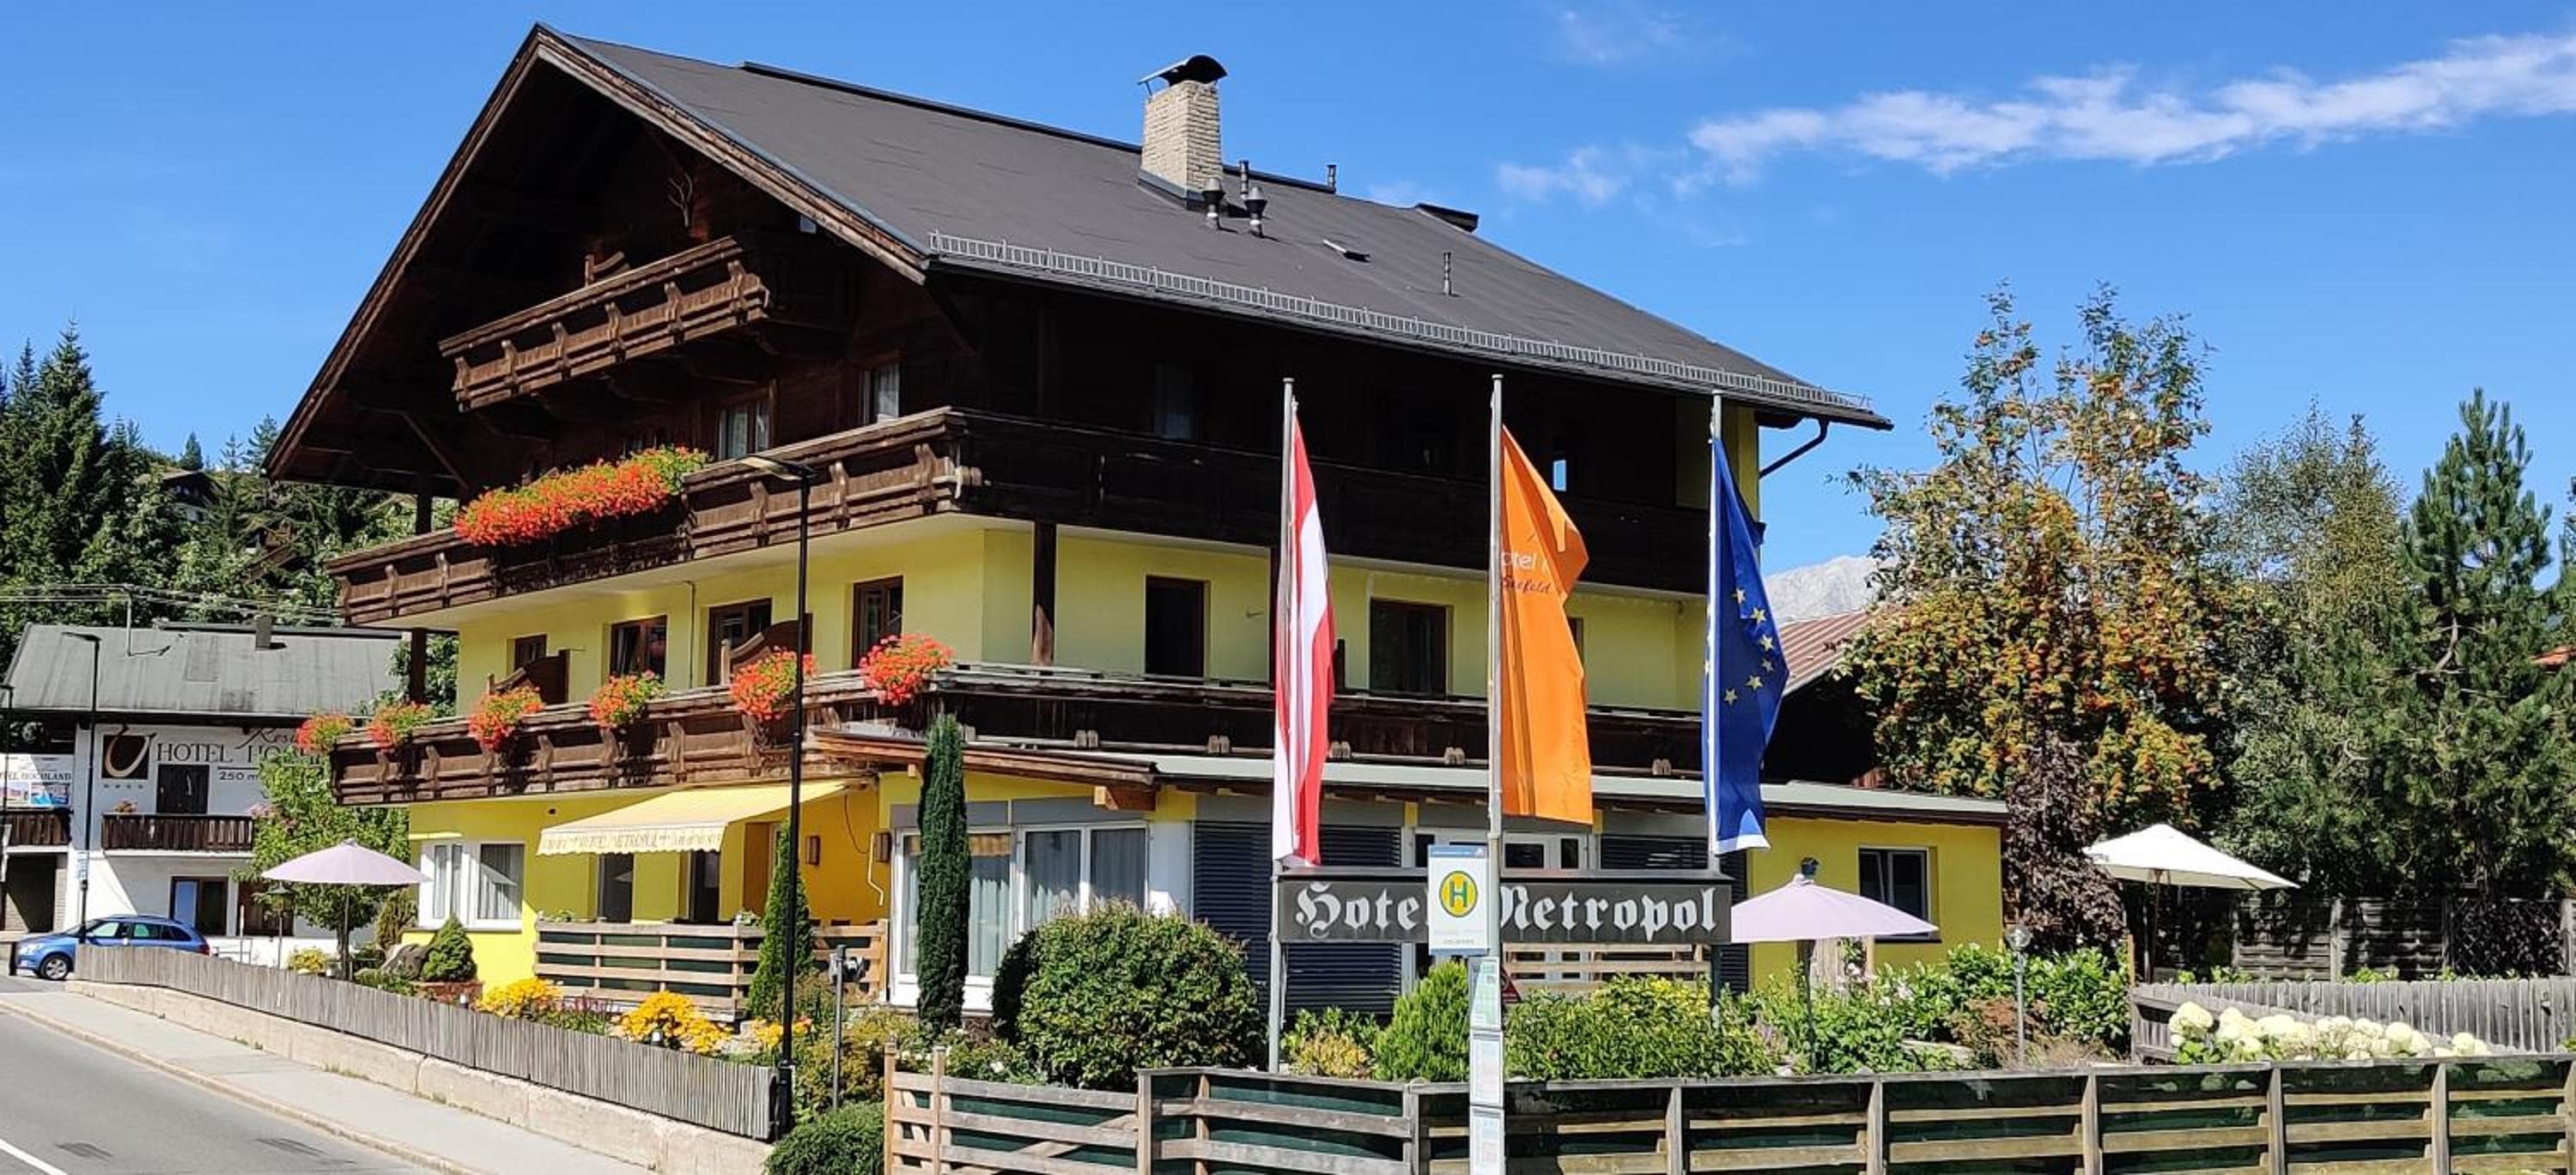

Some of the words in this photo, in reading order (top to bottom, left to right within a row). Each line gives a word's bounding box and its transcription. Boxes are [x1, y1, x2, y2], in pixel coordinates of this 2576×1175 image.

[157, 743, 234, 763] HOTEL
[220, 771, 245, 781] 250
[1449, 880, 1467, 908] H
[1296, 882, 1428, 938] Hote
